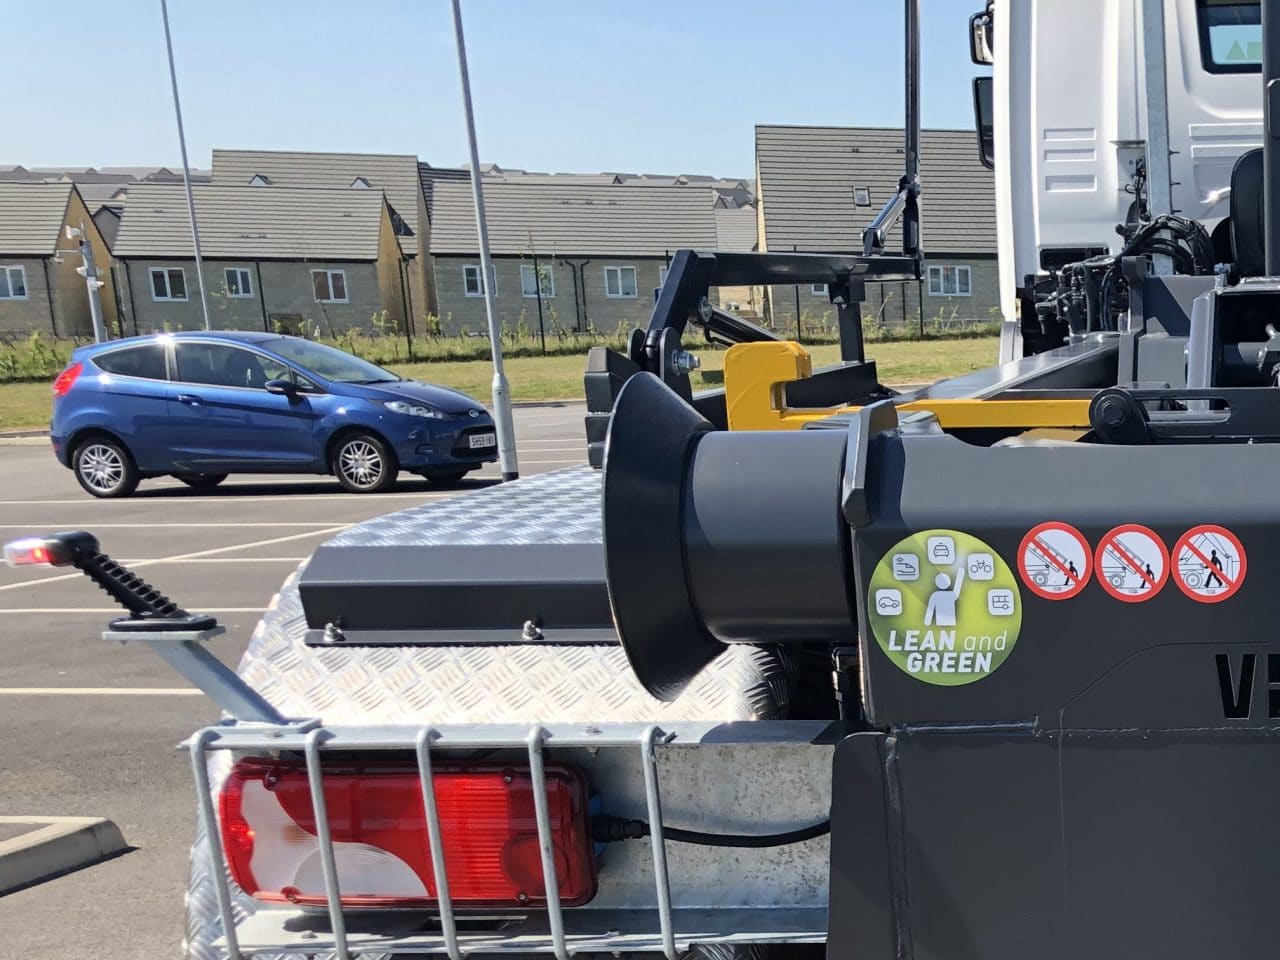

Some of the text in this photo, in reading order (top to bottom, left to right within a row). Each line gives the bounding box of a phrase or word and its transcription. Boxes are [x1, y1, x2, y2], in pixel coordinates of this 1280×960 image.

[888, 630, 1008, 651] LEAN and
[907, 652, 993, 673] GREEN
